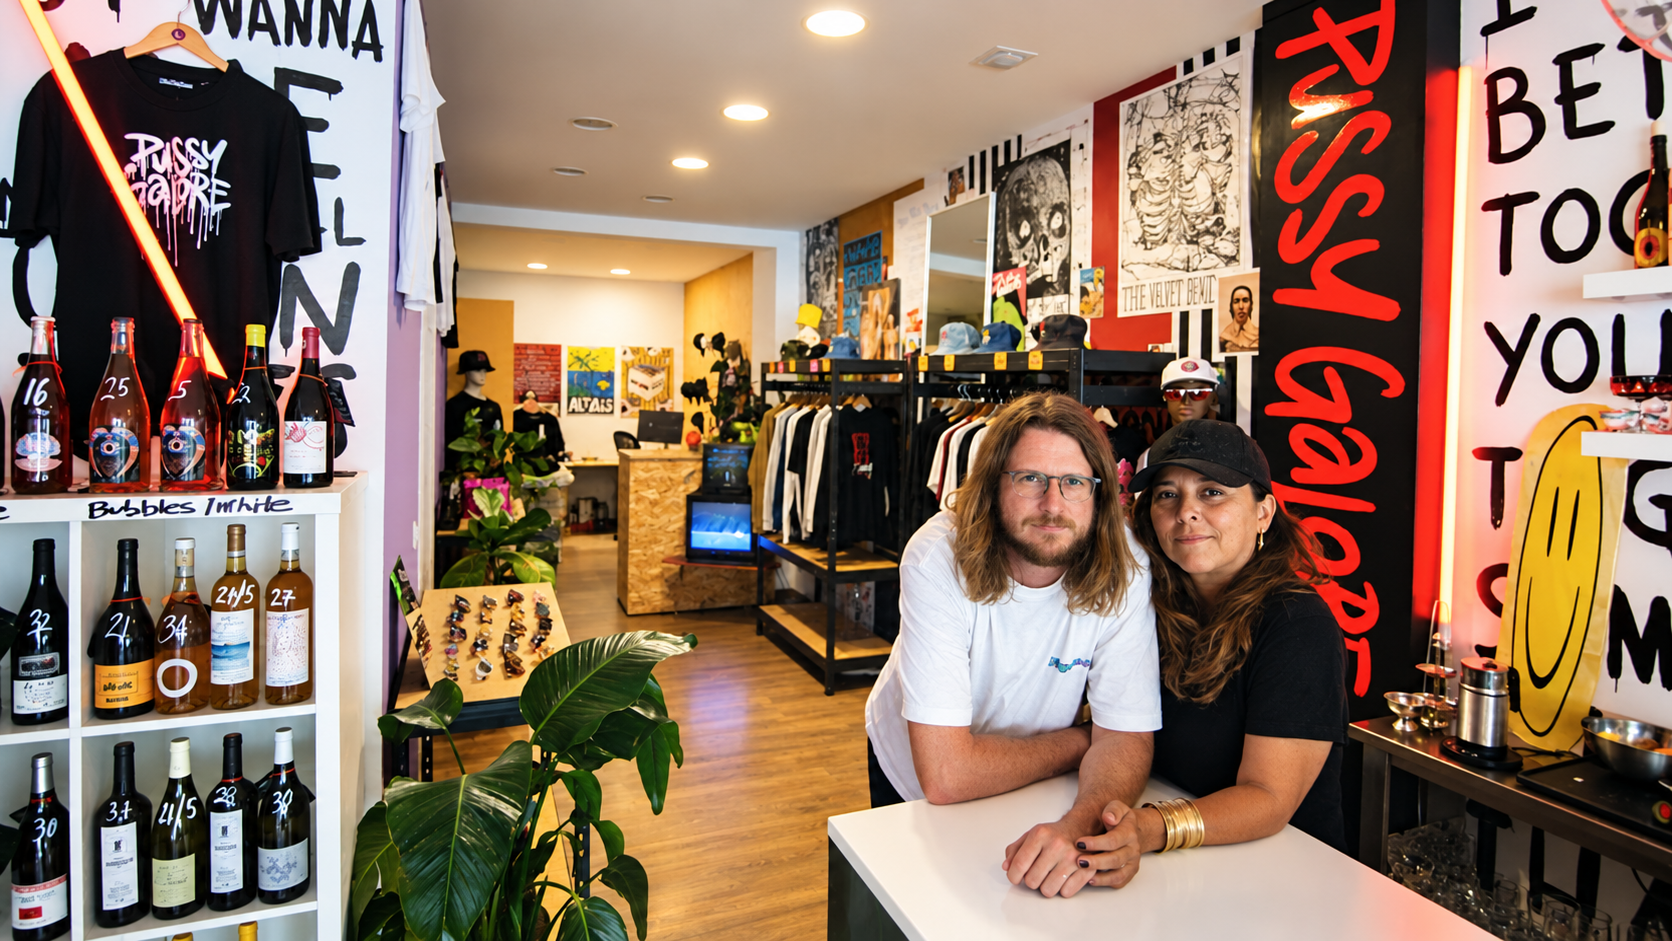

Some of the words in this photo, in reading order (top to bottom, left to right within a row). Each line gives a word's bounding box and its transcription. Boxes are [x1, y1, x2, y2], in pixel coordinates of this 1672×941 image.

[193, 0, 384, 63] WANNA
[1122, 283, 1147, 312] THE
[1149, 278, 1184, 309] VELVET
[23, 377, 50, 407] 16
[100, 376, 130, 401] 25
[88, 499, 196, 519] Bubbles
[270, 588, 296, 607] 27
[32, 817, 58, 843] 30
